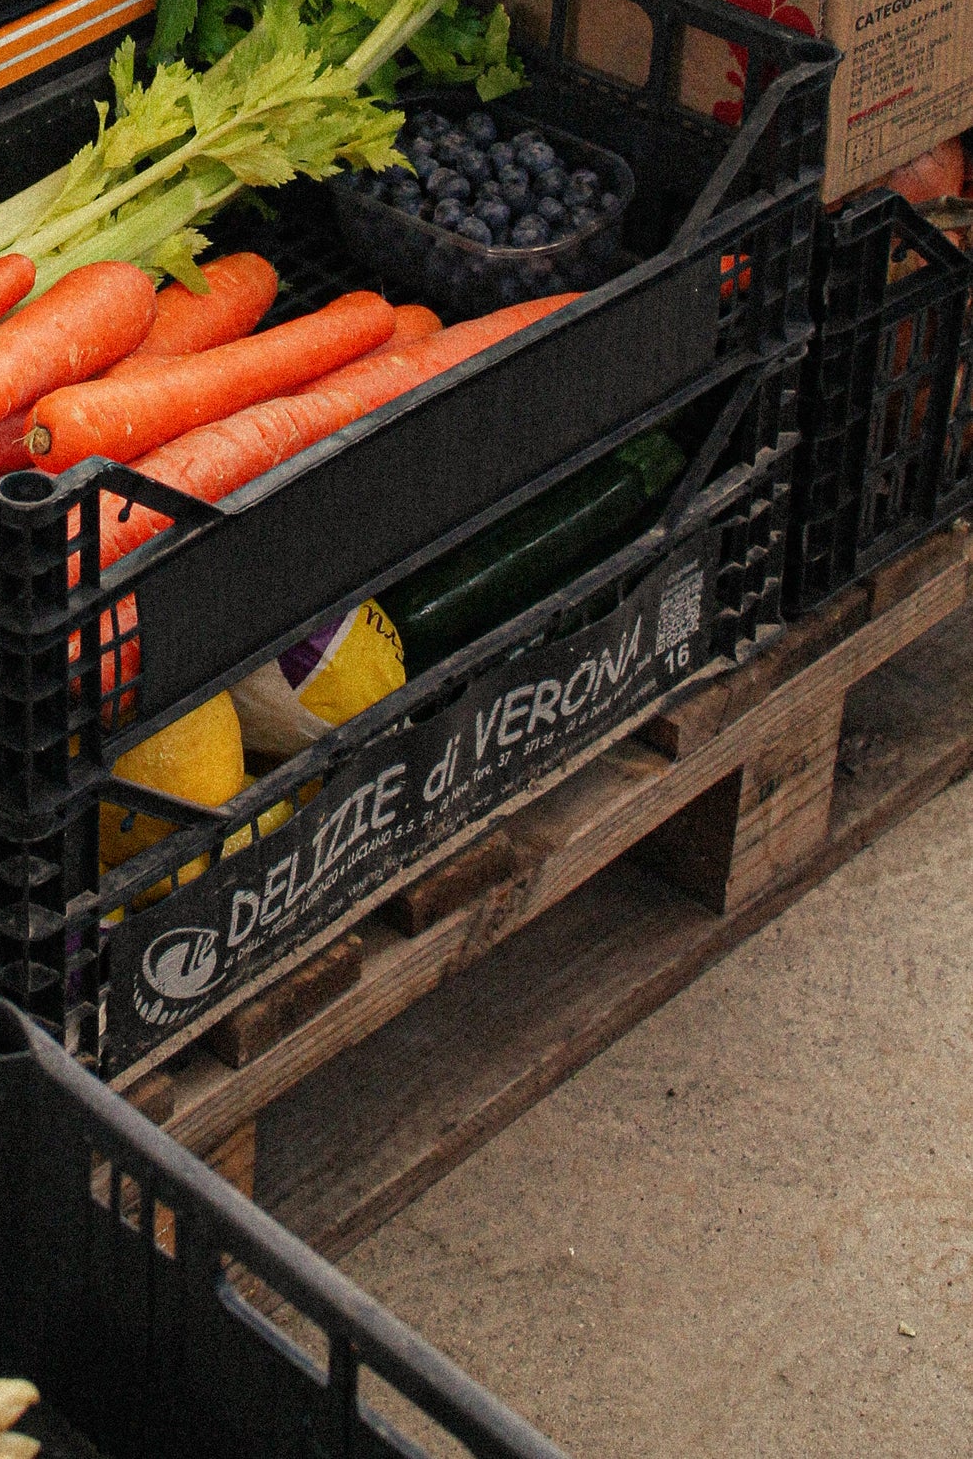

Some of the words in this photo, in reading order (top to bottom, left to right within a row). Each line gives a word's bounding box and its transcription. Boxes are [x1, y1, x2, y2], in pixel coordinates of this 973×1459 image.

[664, 642, 691, 674] 16
[227, 763, 407, 948] DELIZIE
[423, 733, 461, 802] di
[475, 615, 642, 761] VERONA
[347, 830, 392, 870] LUCIANO
[497, 750, 512, 768] 37
